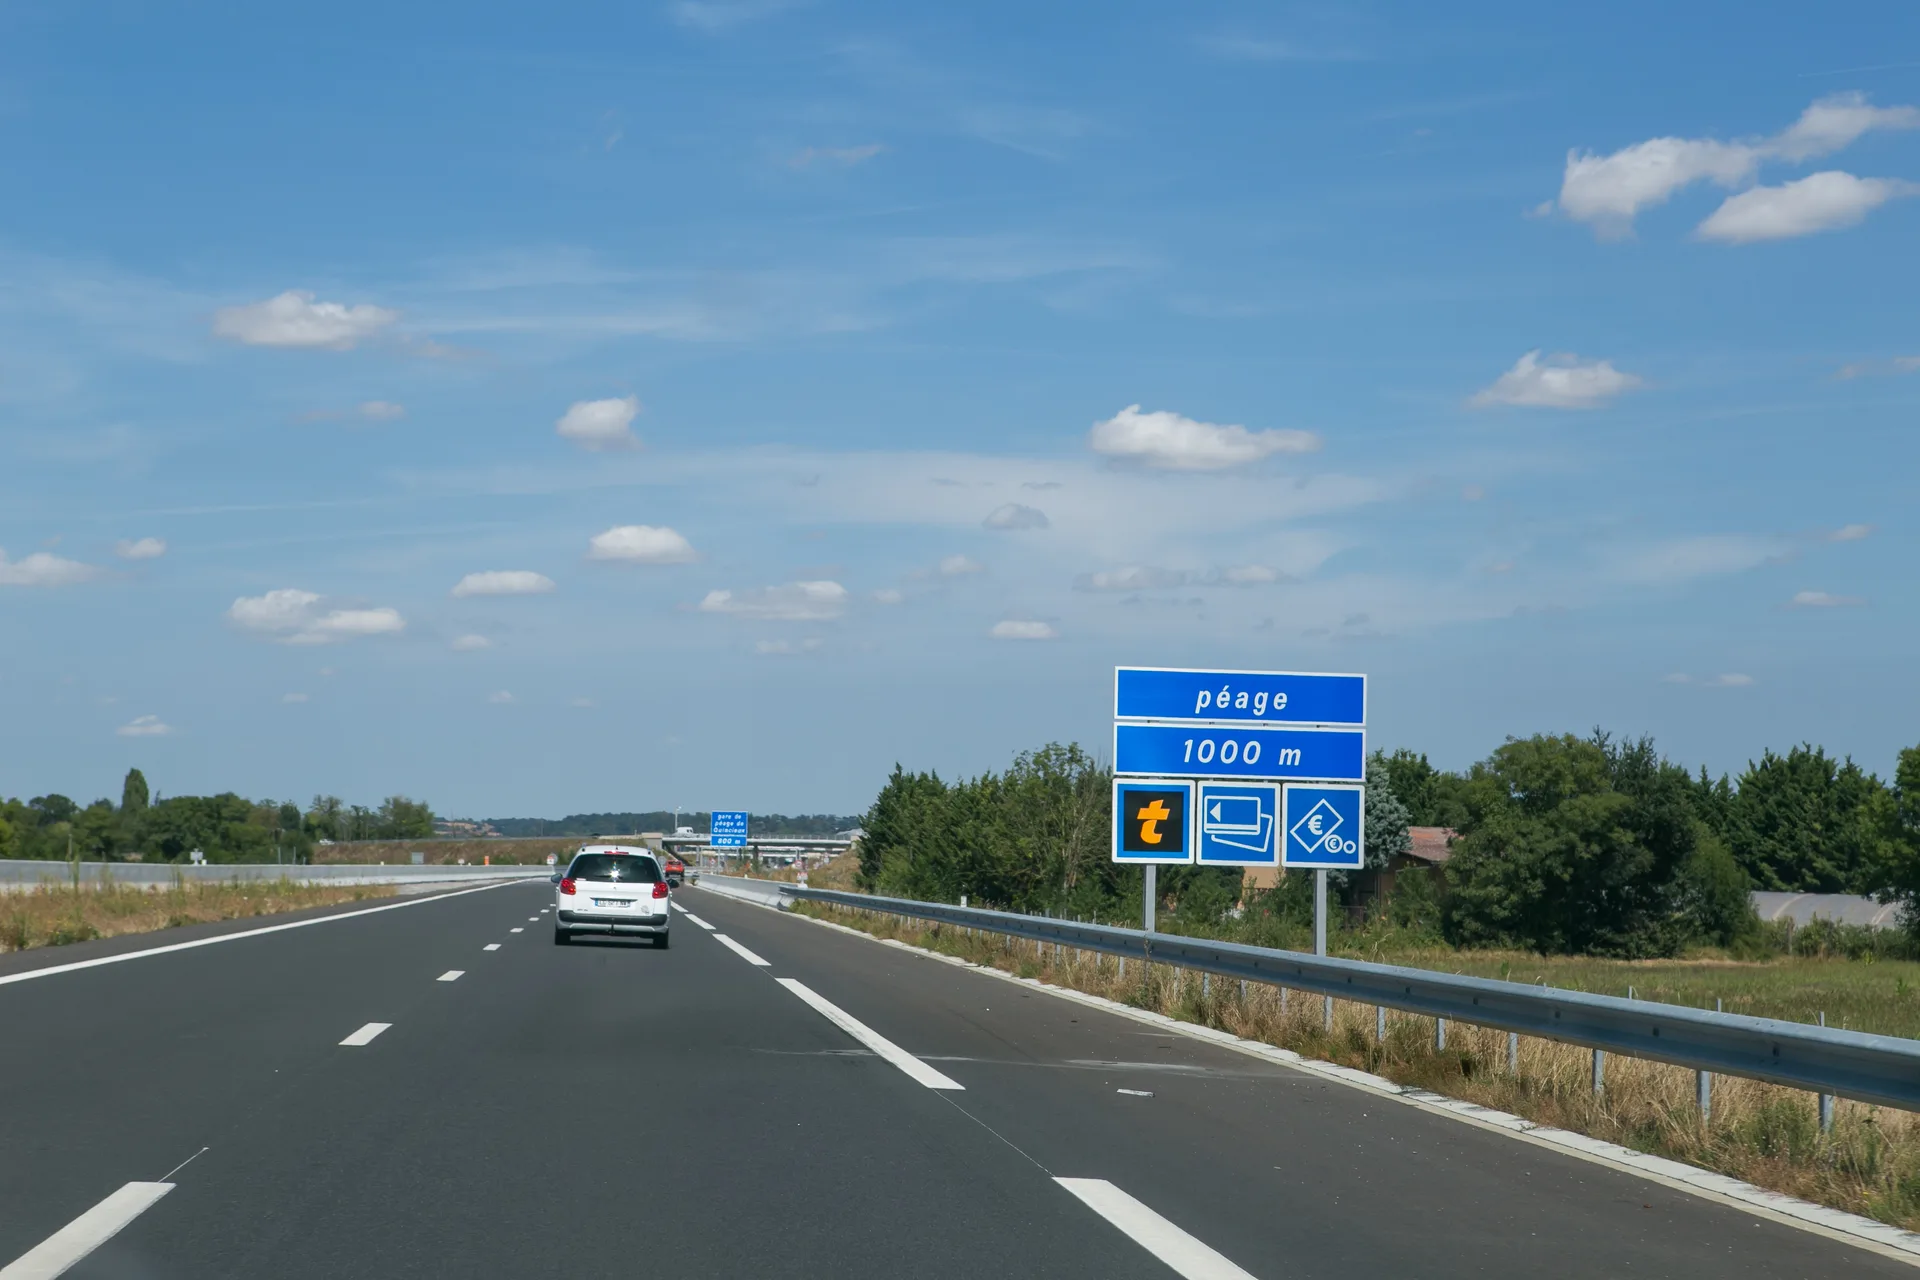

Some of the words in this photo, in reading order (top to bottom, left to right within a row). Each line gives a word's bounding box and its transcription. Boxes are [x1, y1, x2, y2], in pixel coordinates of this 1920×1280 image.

[1195, 686, 1288, 716] péage
[1184, 739, 1261, 765] 1000
[1278, 748, 1301, 766] m
